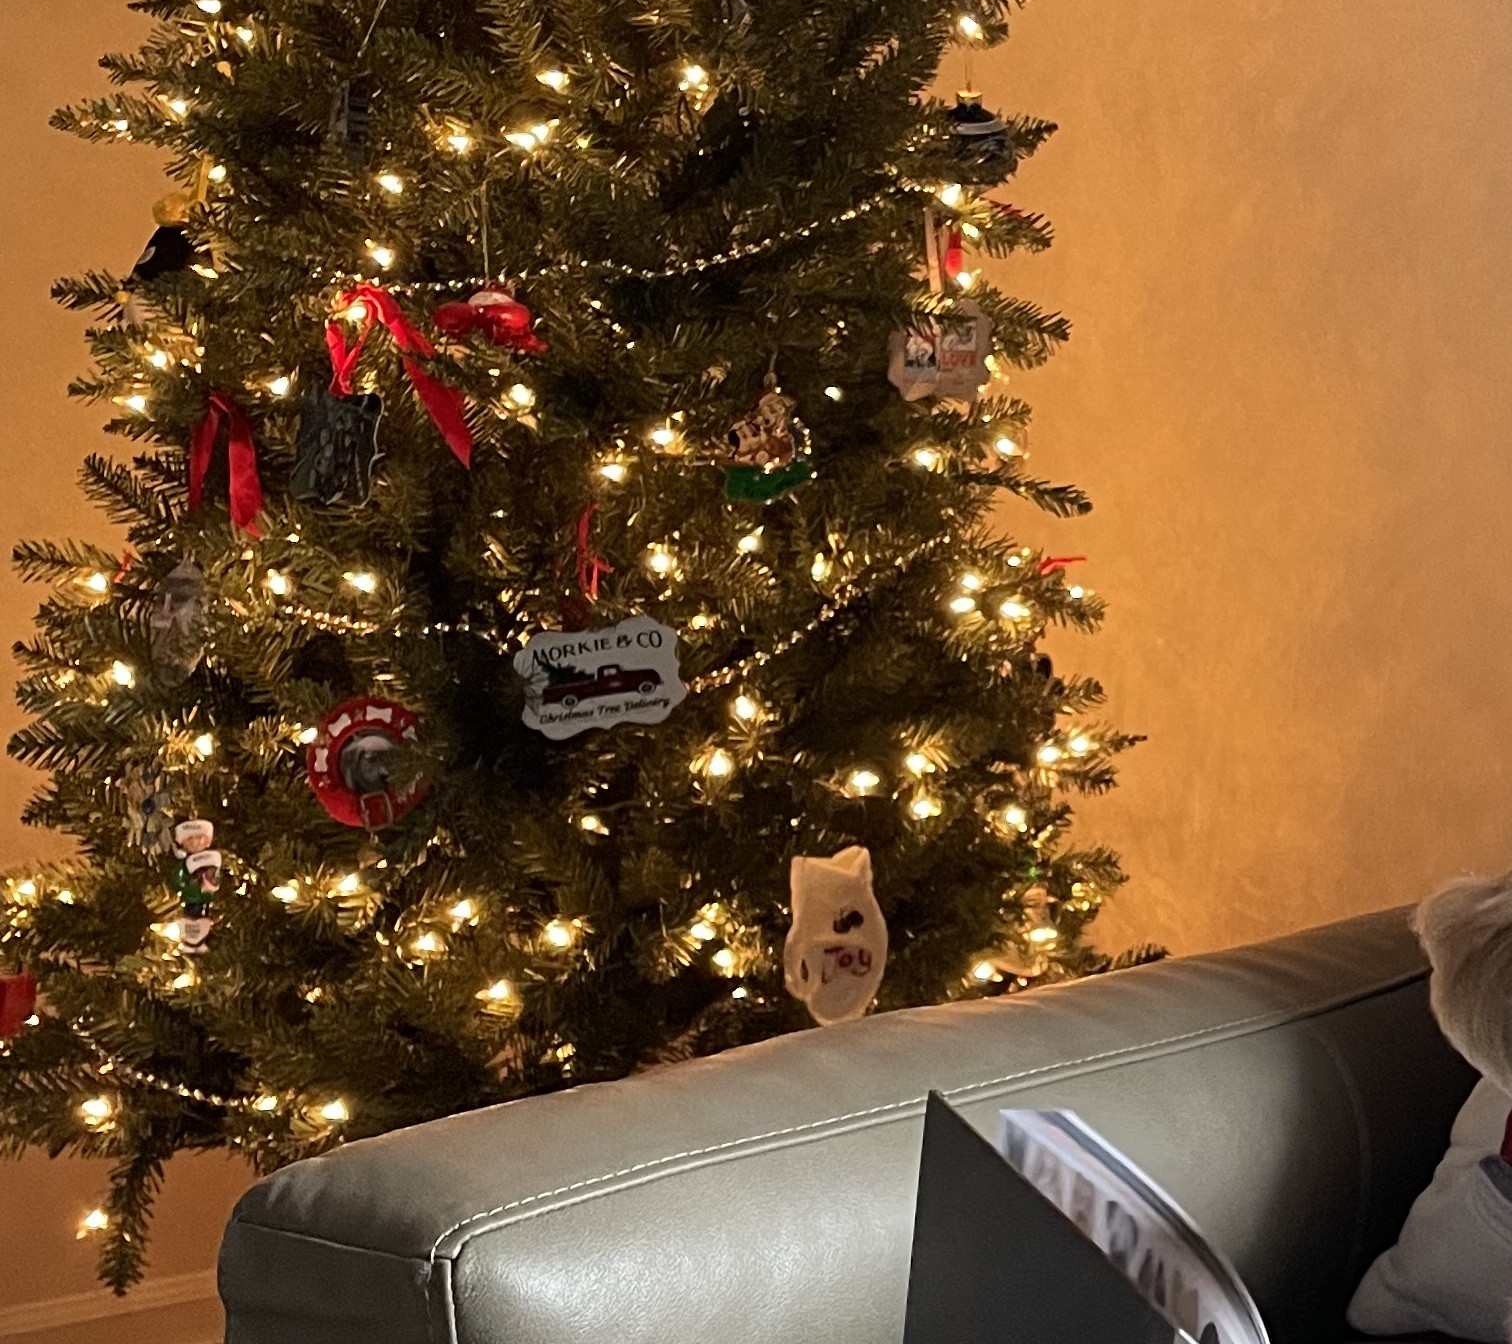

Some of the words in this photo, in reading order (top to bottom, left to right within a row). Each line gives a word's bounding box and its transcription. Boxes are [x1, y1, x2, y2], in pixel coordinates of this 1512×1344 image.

[532, 638, 612, 666] MORKIE
[616, 634, 633, 649] &
[636, 630, 663, 649] CO
[539, 707, 594, 725] Christmas
[598, 704, 620, 717] Tree
